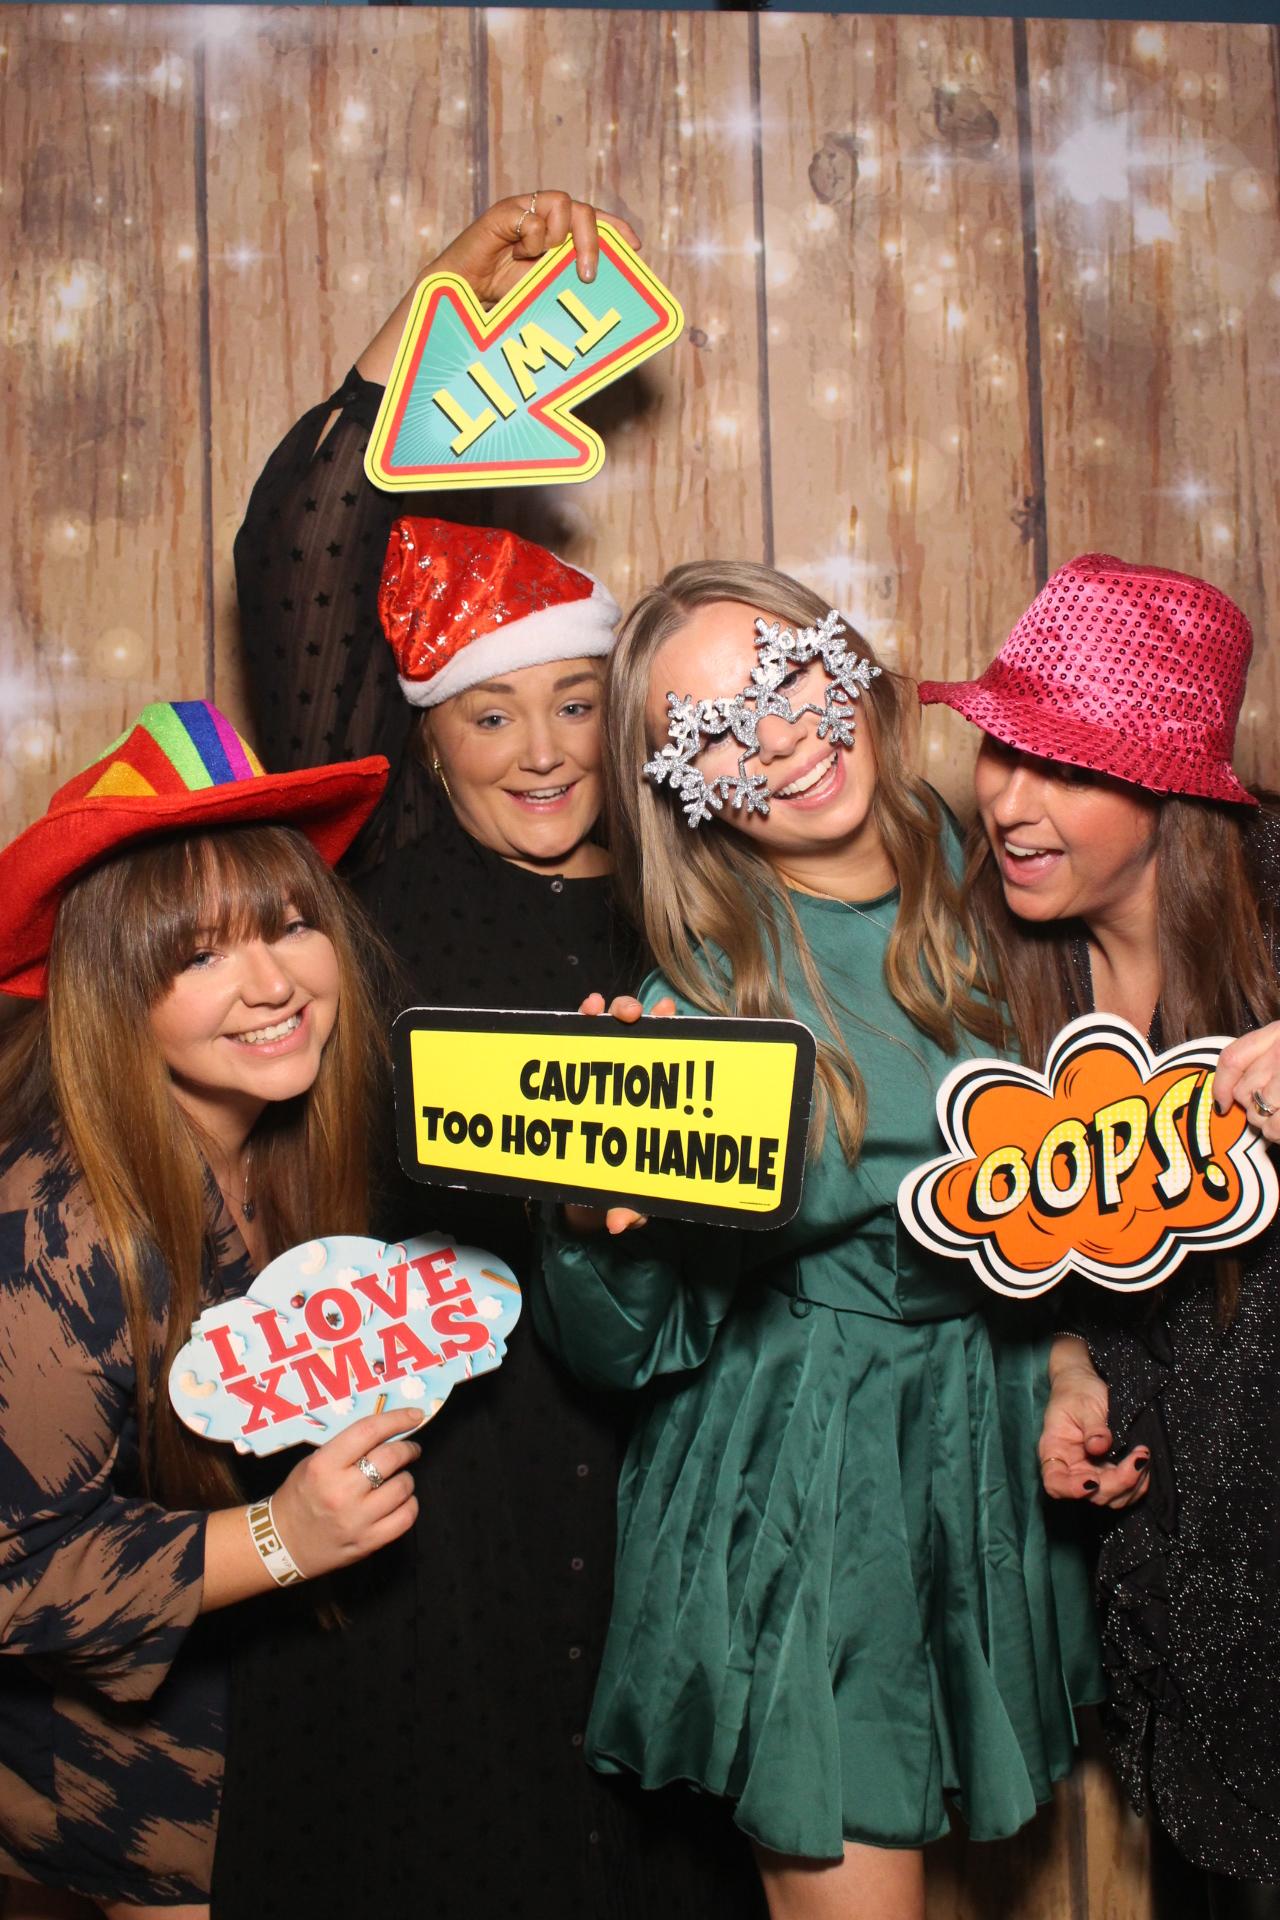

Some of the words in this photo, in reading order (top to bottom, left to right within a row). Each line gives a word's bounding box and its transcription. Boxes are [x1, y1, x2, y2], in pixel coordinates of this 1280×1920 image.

[432, 288, 622, 458] TWIT
[422, 1105, 494, 1149] TOO
[500, 1114, 573, 1160] HOT
[580, 1120, 627, 1168] TO
[635, 1126, 780, 1191] HANDLE
[519, 1059, 715, 1119] CAUTION!!
[967, 1069, 1230, 1222] OOPS!
[204, 1324, 246, 1382] I
[252, 1247, 473, 1362] LOVE
[225, 1297, 492, 1436] XMAS
